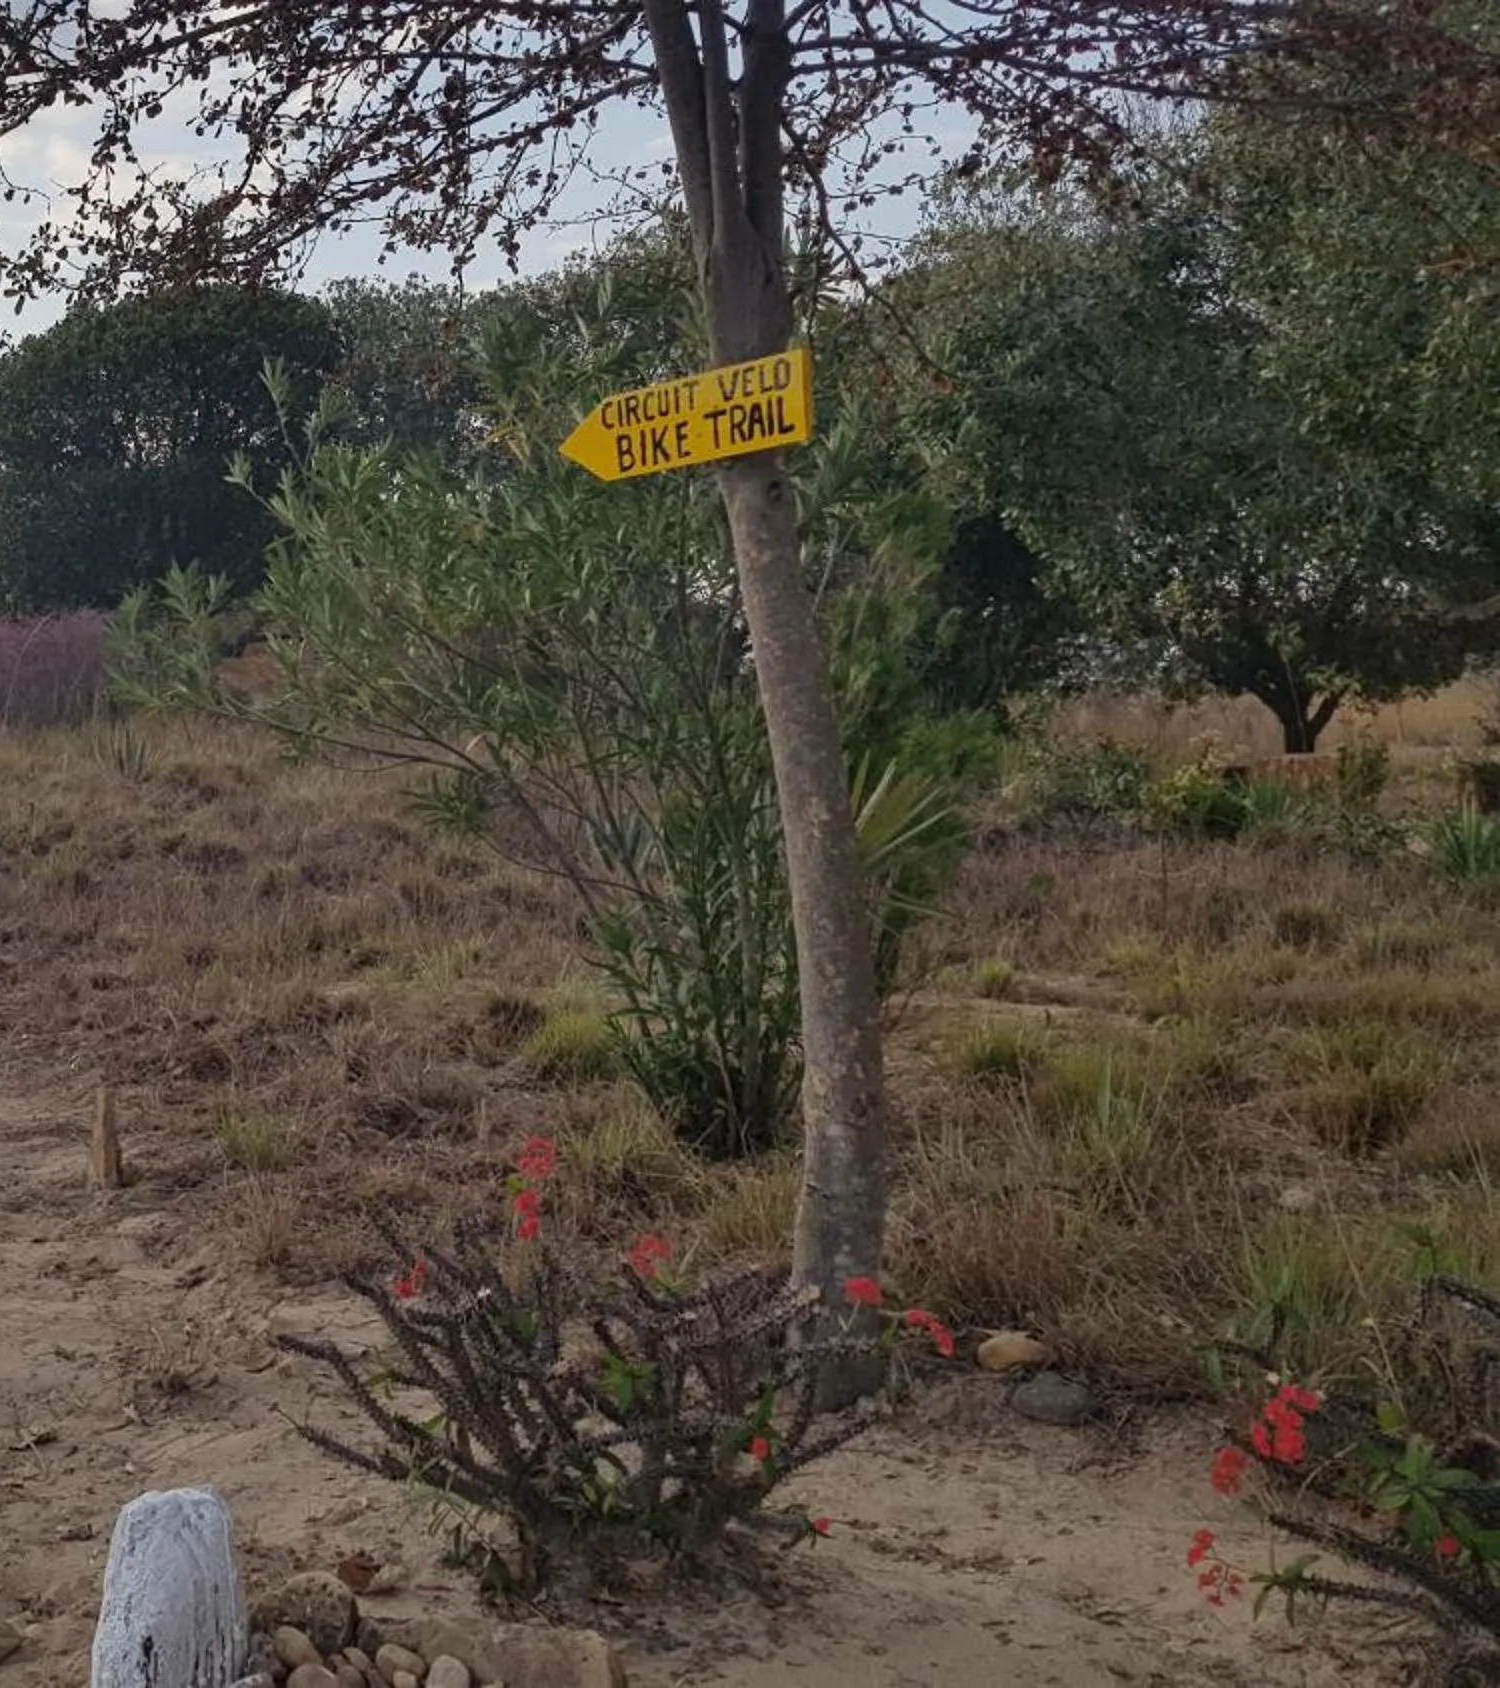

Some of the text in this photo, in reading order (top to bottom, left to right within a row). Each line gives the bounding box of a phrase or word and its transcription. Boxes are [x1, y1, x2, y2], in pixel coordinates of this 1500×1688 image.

[601, 381, 700, 430] CIRCUIT
[615, 397, 795, 473] BIKE TRAIL
